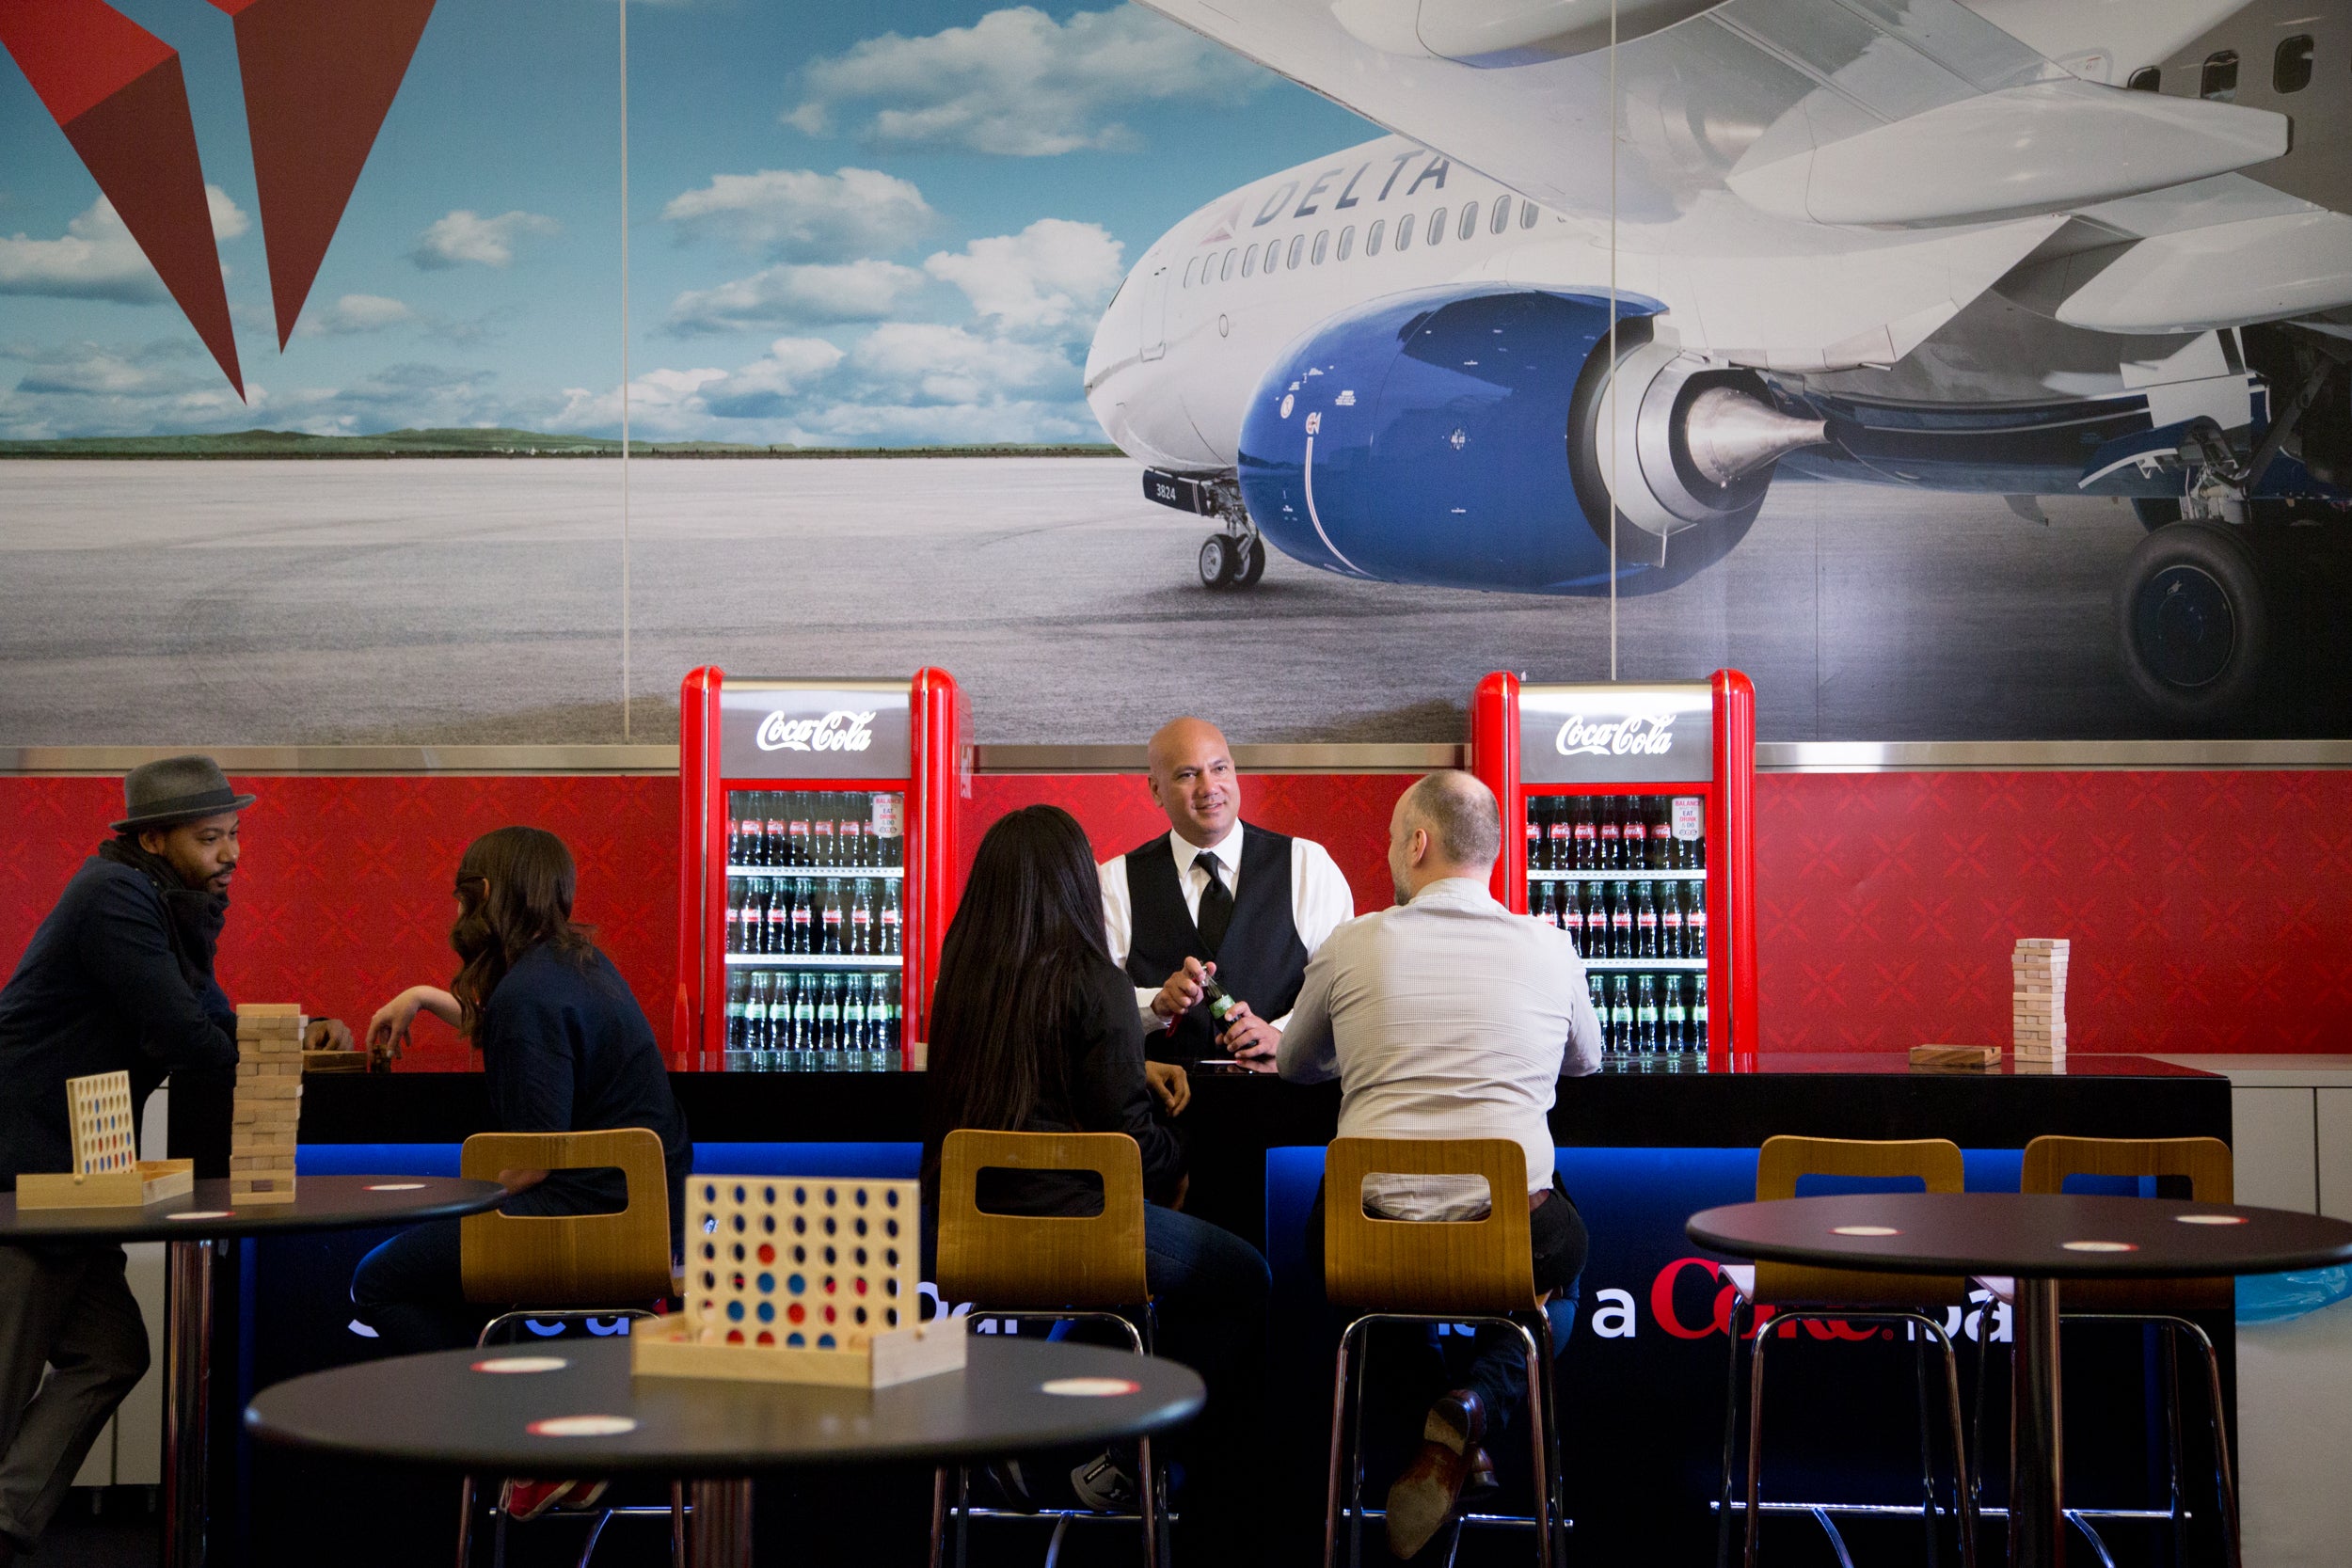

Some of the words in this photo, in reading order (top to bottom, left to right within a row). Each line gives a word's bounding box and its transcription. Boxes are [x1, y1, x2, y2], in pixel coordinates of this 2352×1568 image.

[1252, 149, 1451, 228] DELTA
[1156, 483, 1176, 500] 3824
[755, 710, 877, 752] Coca-Cola
[1555, 714, 1677, 755] Coca-Cola
[1591, 1287, 1636, 1338] a
